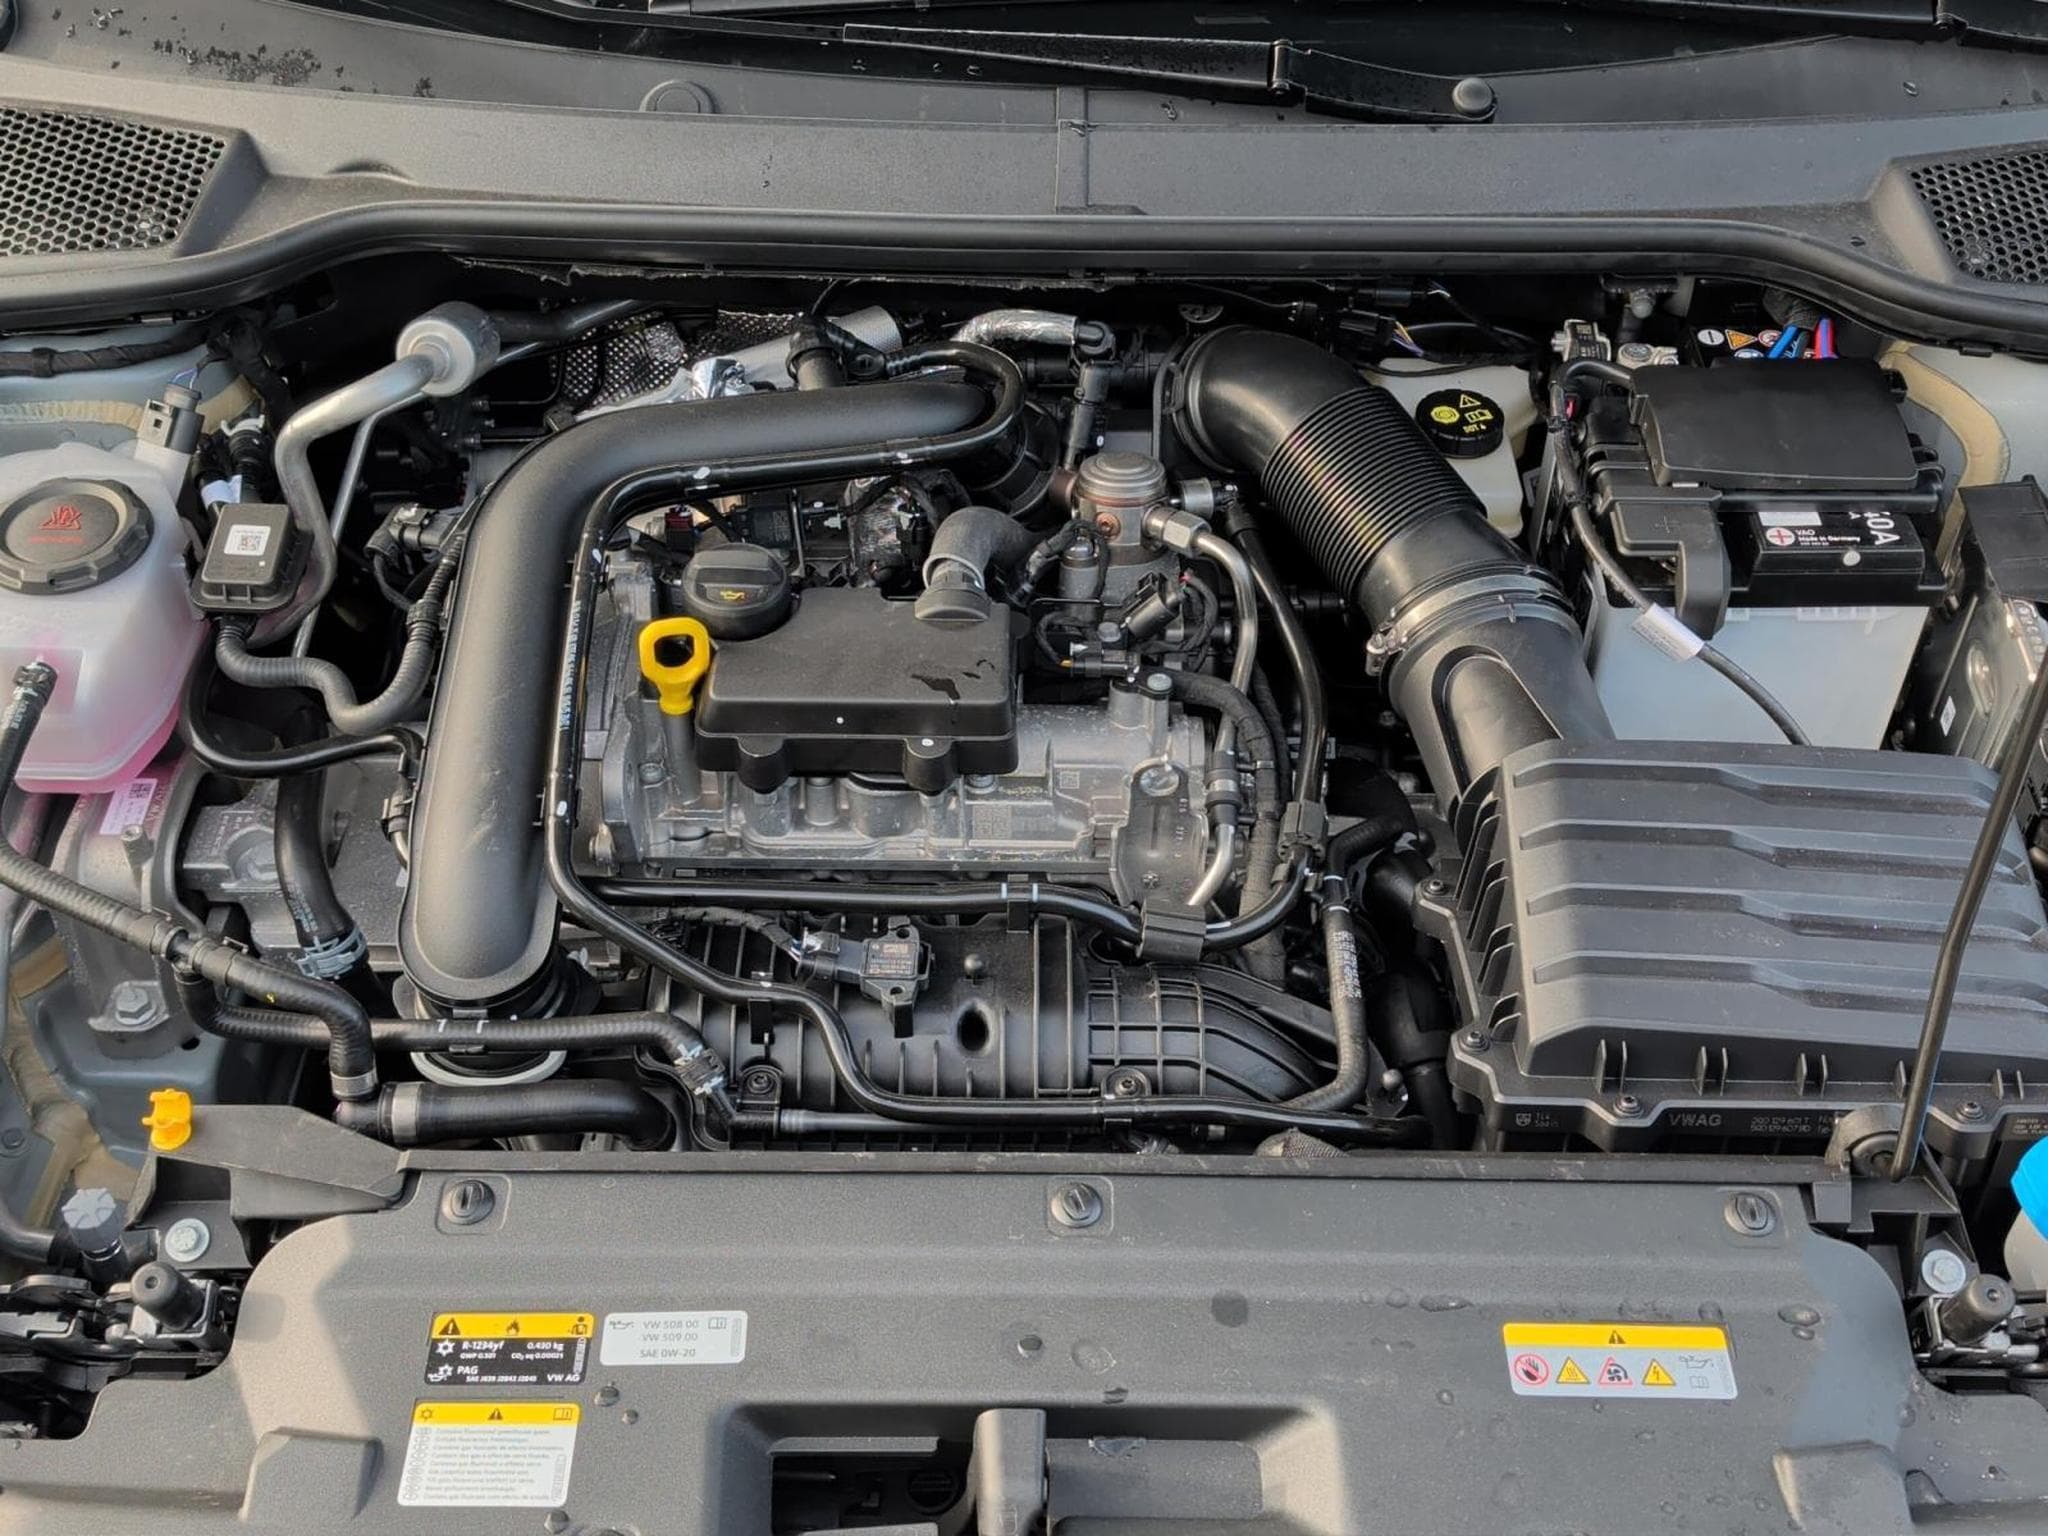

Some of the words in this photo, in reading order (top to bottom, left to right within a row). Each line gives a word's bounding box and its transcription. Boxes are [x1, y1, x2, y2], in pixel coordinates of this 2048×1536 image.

[1669, 1114, 1721, 1126] VWAG
[642, 1320, 660, 1329] VW
[663, 1320, 683, 1329] 508
[686, 1320, 699, 1328] 00
[641, 1333, 660, 1341] VW
[662, 1333, 682, 1341] 509
[684, 1332, 698, 1341] 00
[462, 1341, 505, 1353] R-1234yf
[553, 1341, 564, 1352] kg
[640, 1348, 659, 1358] SAE
[661, 1348, 696, 1357] 0W-20
[457, 1365, 479, 1375] PAG
[547, 1373, 564, 1382] VW
[564, 1373, 581, 1382] AG
